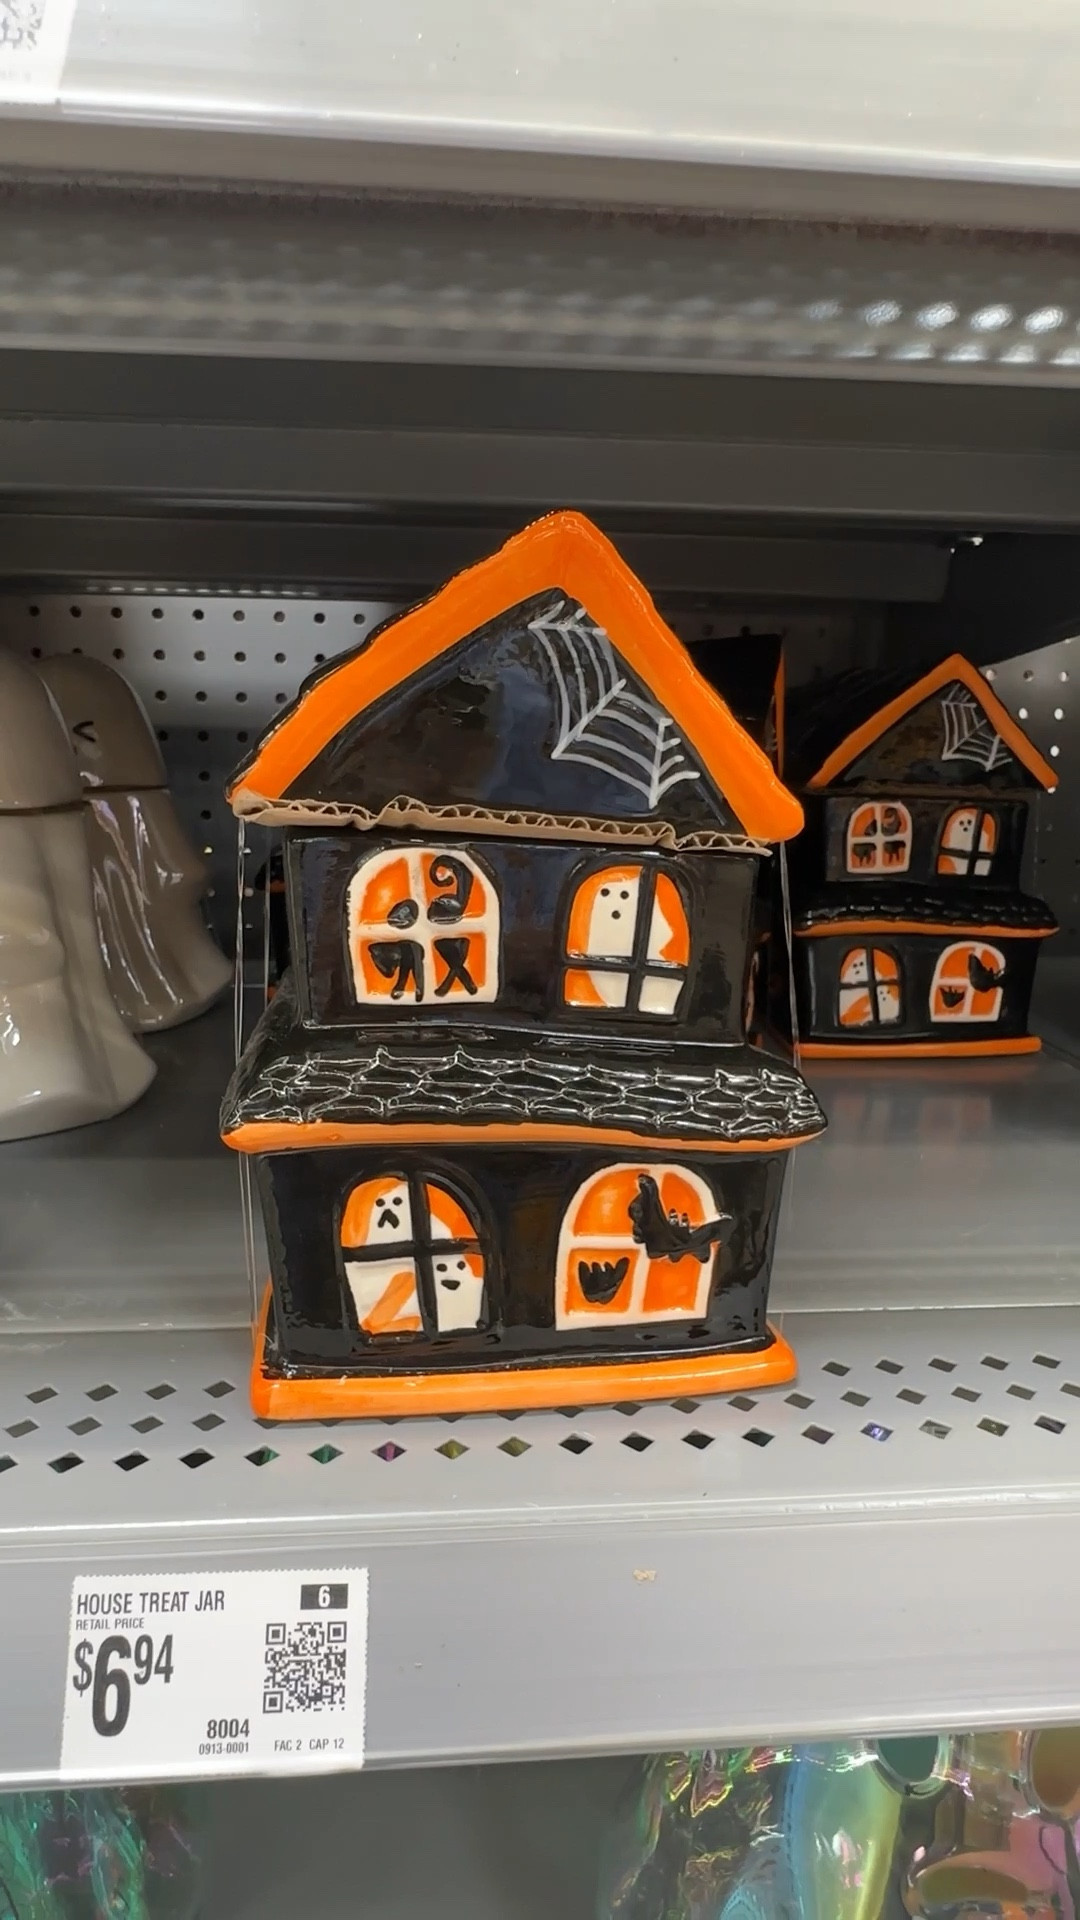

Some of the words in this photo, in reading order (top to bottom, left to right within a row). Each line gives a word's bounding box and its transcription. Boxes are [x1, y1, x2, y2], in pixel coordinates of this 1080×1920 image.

[77, 1592, 133, 1615] HOUSE
[139, 1591, 190, 1613] TREAT
[194, 1590, 225, 1612] JAR
[318, 1585, 331, 1608] 6
[75, 1618, 110, 1631] RETAIL
[114, 1617, 145, 1629] PRICE
[207, 1719, 250, 1739] 8004
[198, 1742, 250, 1755] 0913-0001
[274, 1740, 293, 1751] FAC
[295, 1739, 302, 1751] 2
[309, 1738, 329, 1750] CAP
[333, 1738, 345, 1749] 12
